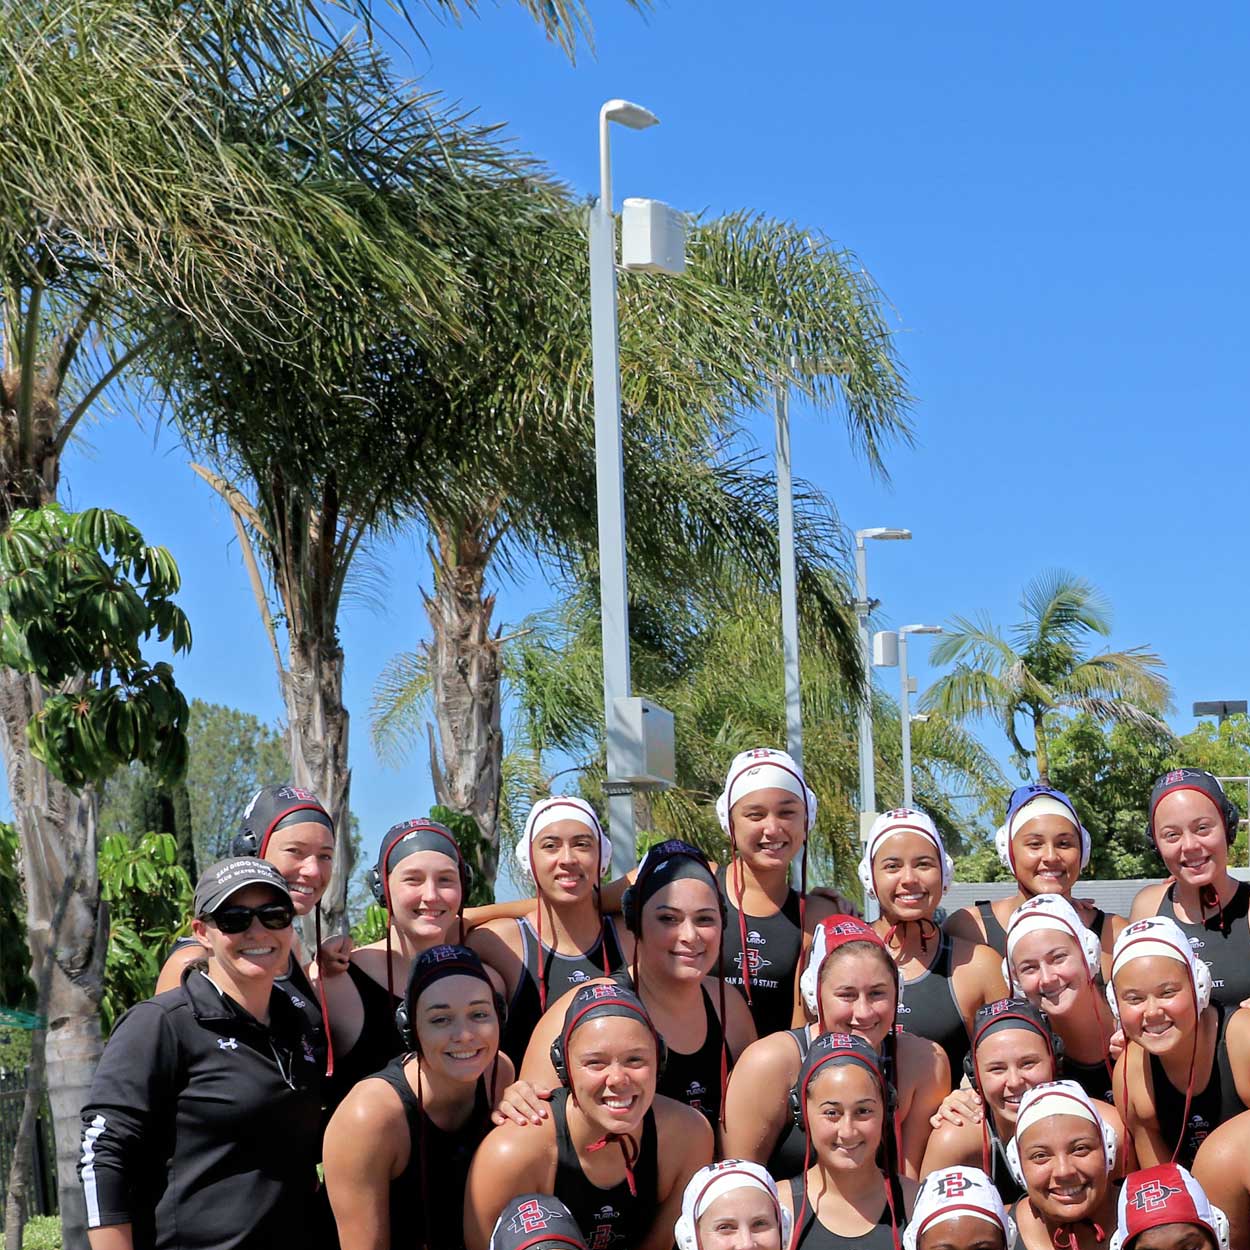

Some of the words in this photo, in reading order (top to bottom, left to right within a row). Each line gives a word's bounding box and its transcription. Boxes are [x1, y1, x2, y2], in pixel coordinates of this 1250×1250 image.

[230, 860, 252, 870] DIEGO
[724, 976, 741, 985] SAN
[758, 978, 779, 989] STATE
[686, 1087, 706, 1096] TURBO
[1188, 1121, 1209, 1129] TURBO
